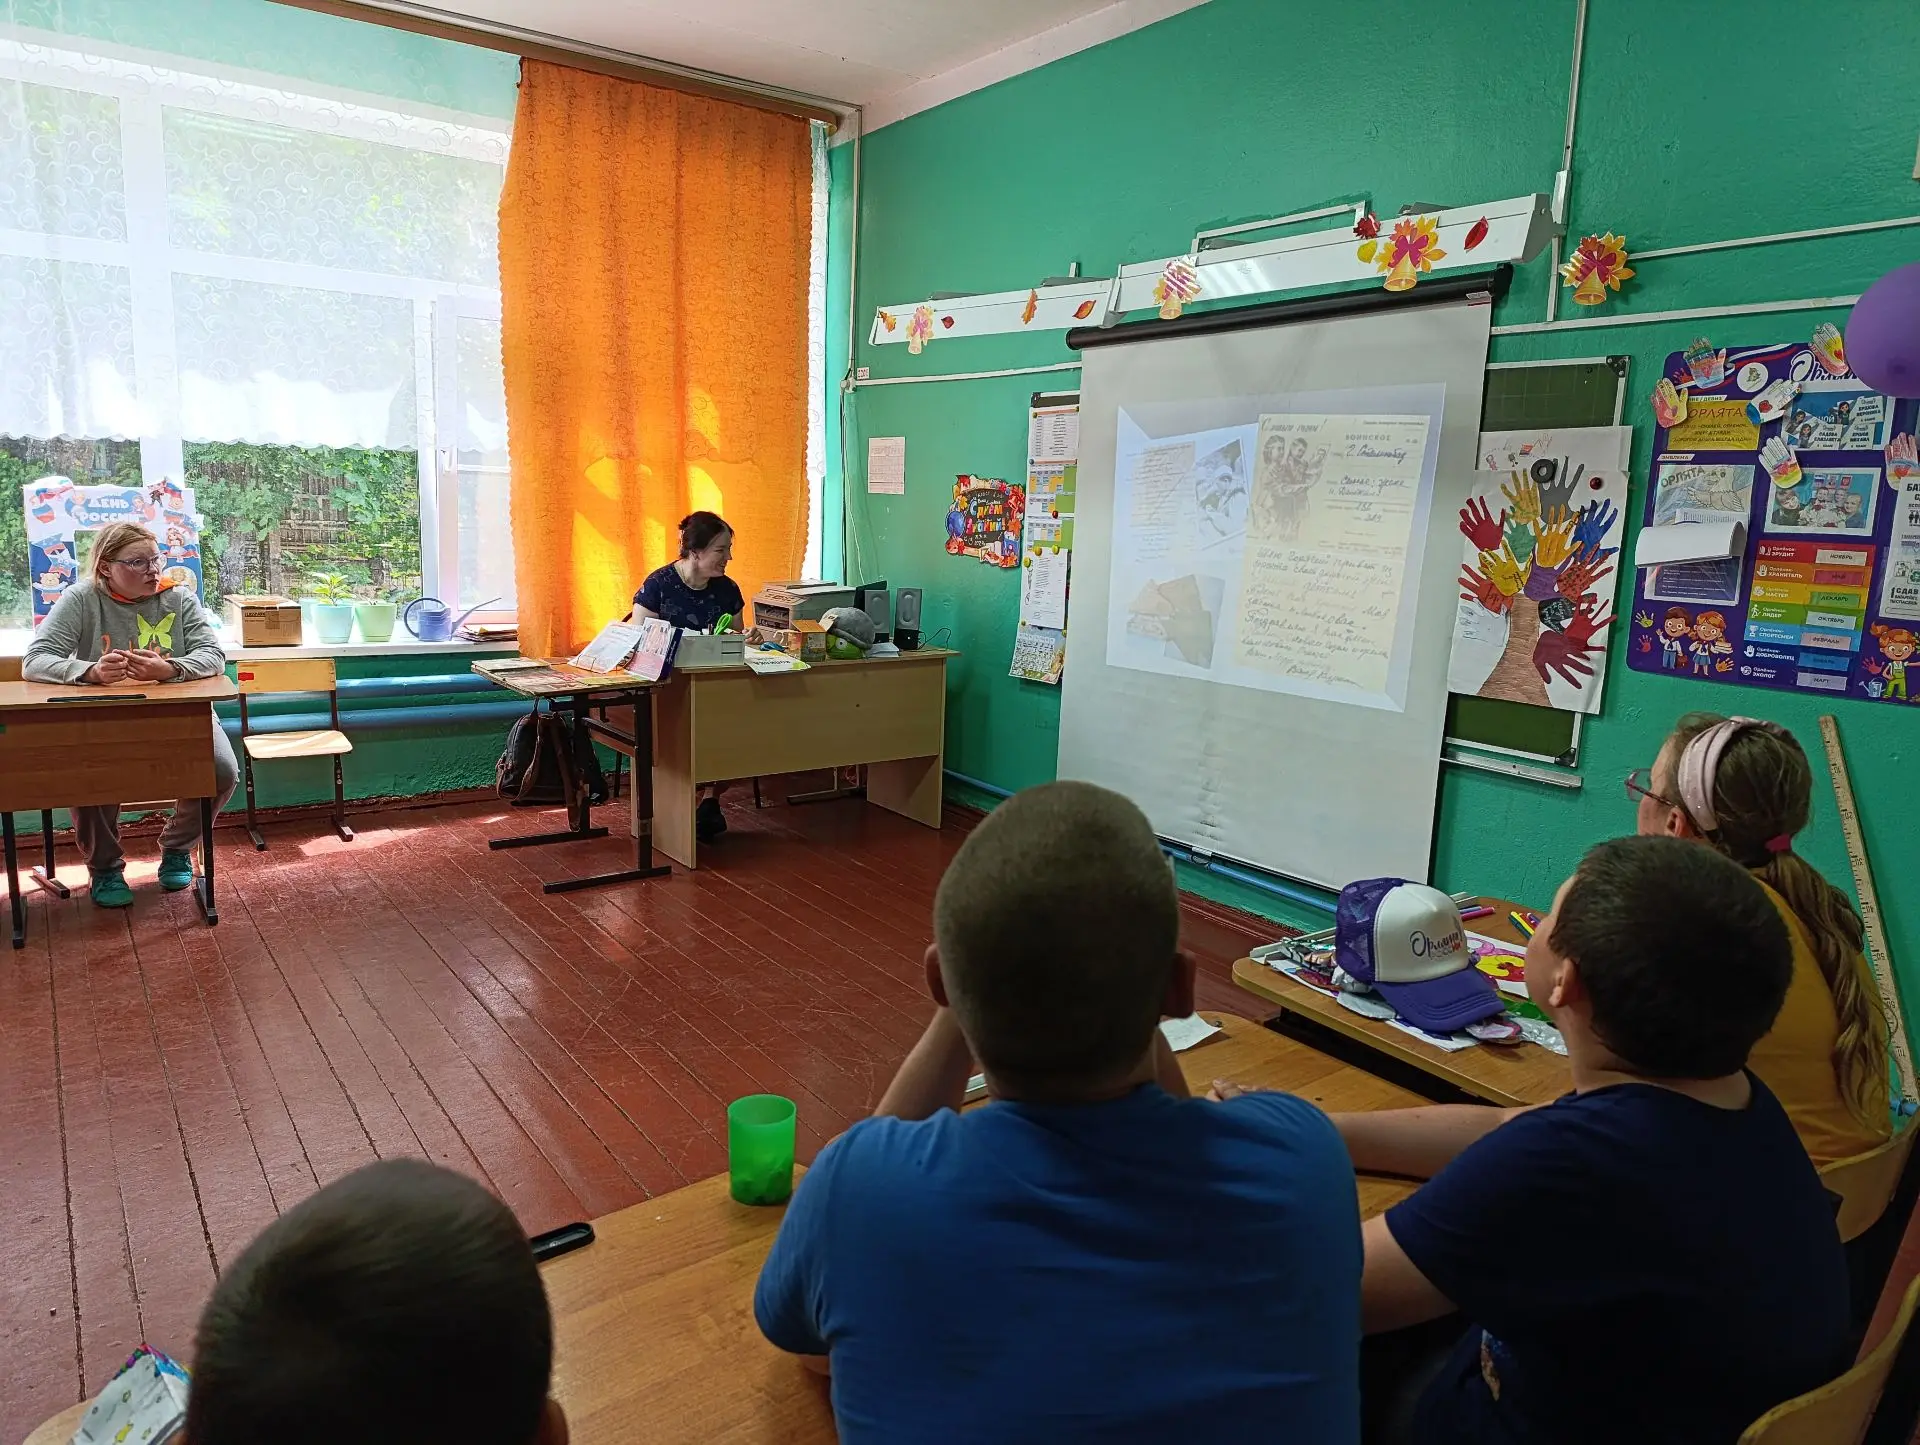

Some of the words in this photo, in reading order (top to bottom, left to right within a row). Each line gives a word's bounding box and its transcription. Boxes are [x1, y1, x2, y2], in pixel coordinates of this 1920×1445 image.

[1660, 466, 1706, 488] ОРЛЯТА
[88, 499, 129, 508] ДЕНЬ
[1759, 632, 1794, 640] СПОРТСМЕН
[1755, 652, 1795, 661] ДОБРОВОЛЕЦ
